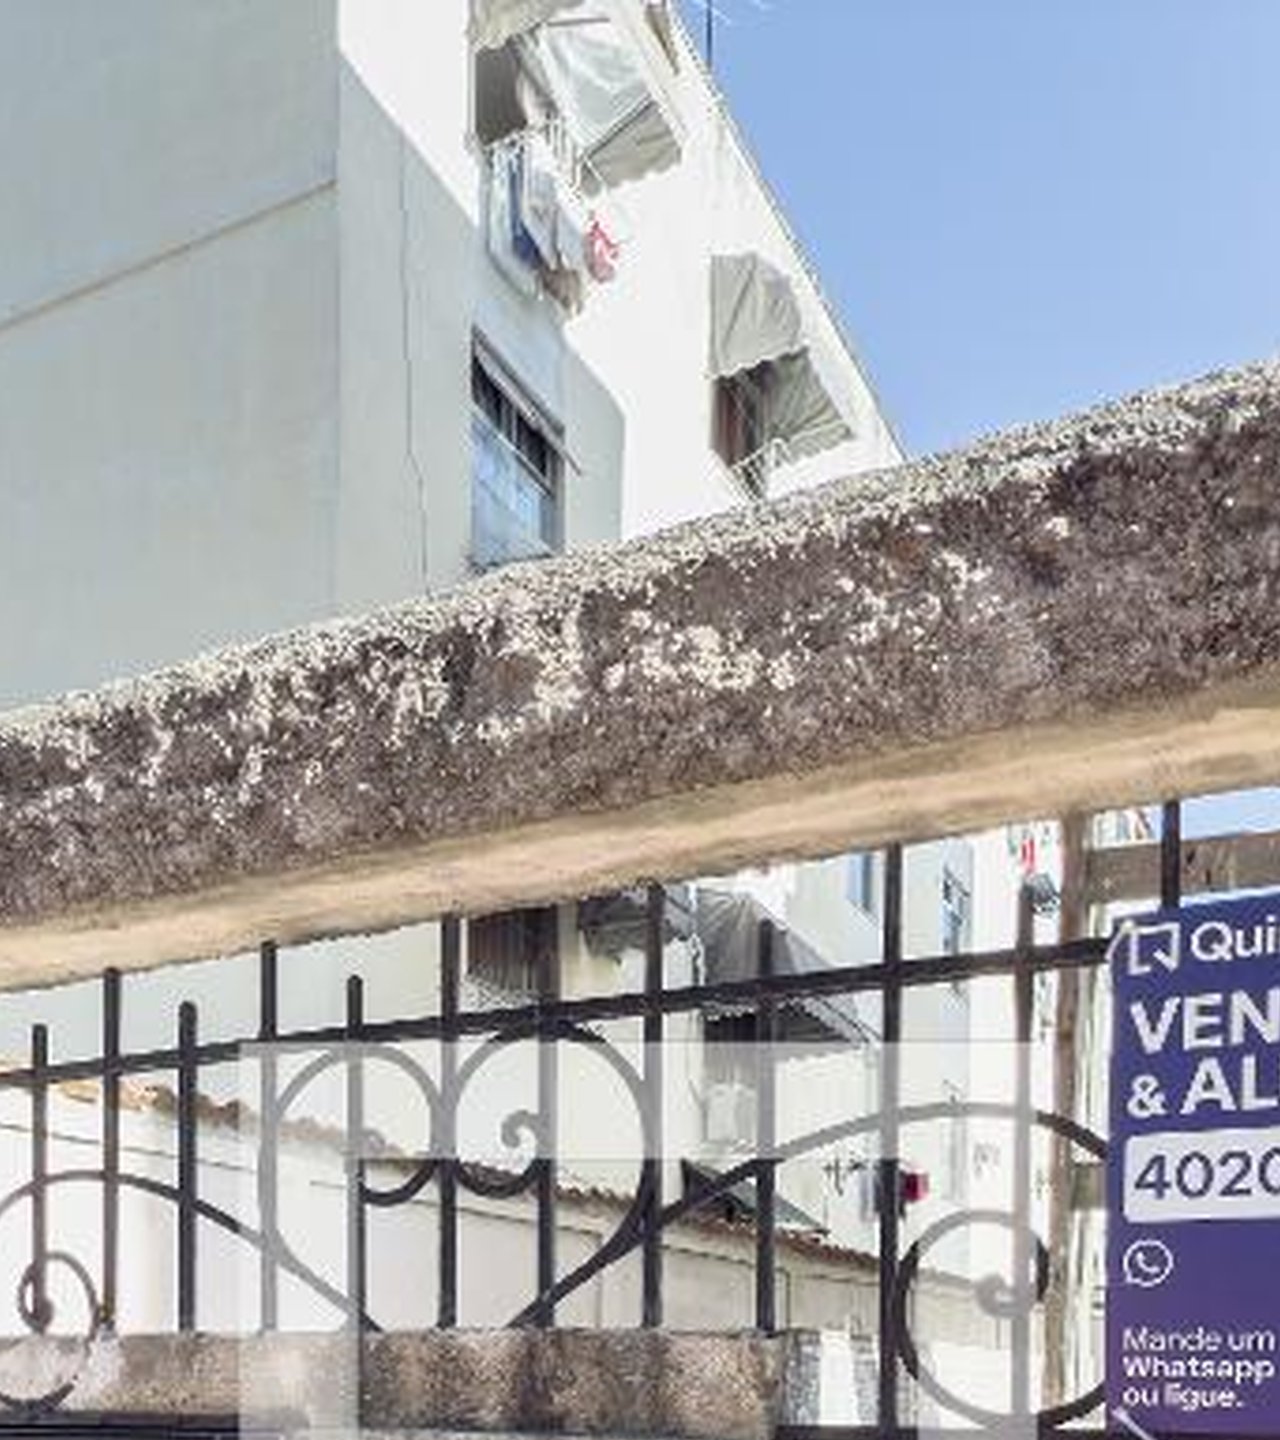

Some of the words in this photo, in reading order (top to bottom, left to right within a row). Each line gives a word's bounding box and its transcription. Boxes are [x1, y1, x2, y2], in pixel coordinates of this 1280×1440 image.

[1126, 1075, 1167, 1119] &
[1122, 1326, 1222, 1351] Mande
[1227, 1330, 1275, 1351] um
[1122, 1356, 1275, 1385] Whatsapp
[1122, 1387, 1159, 1407] ou
